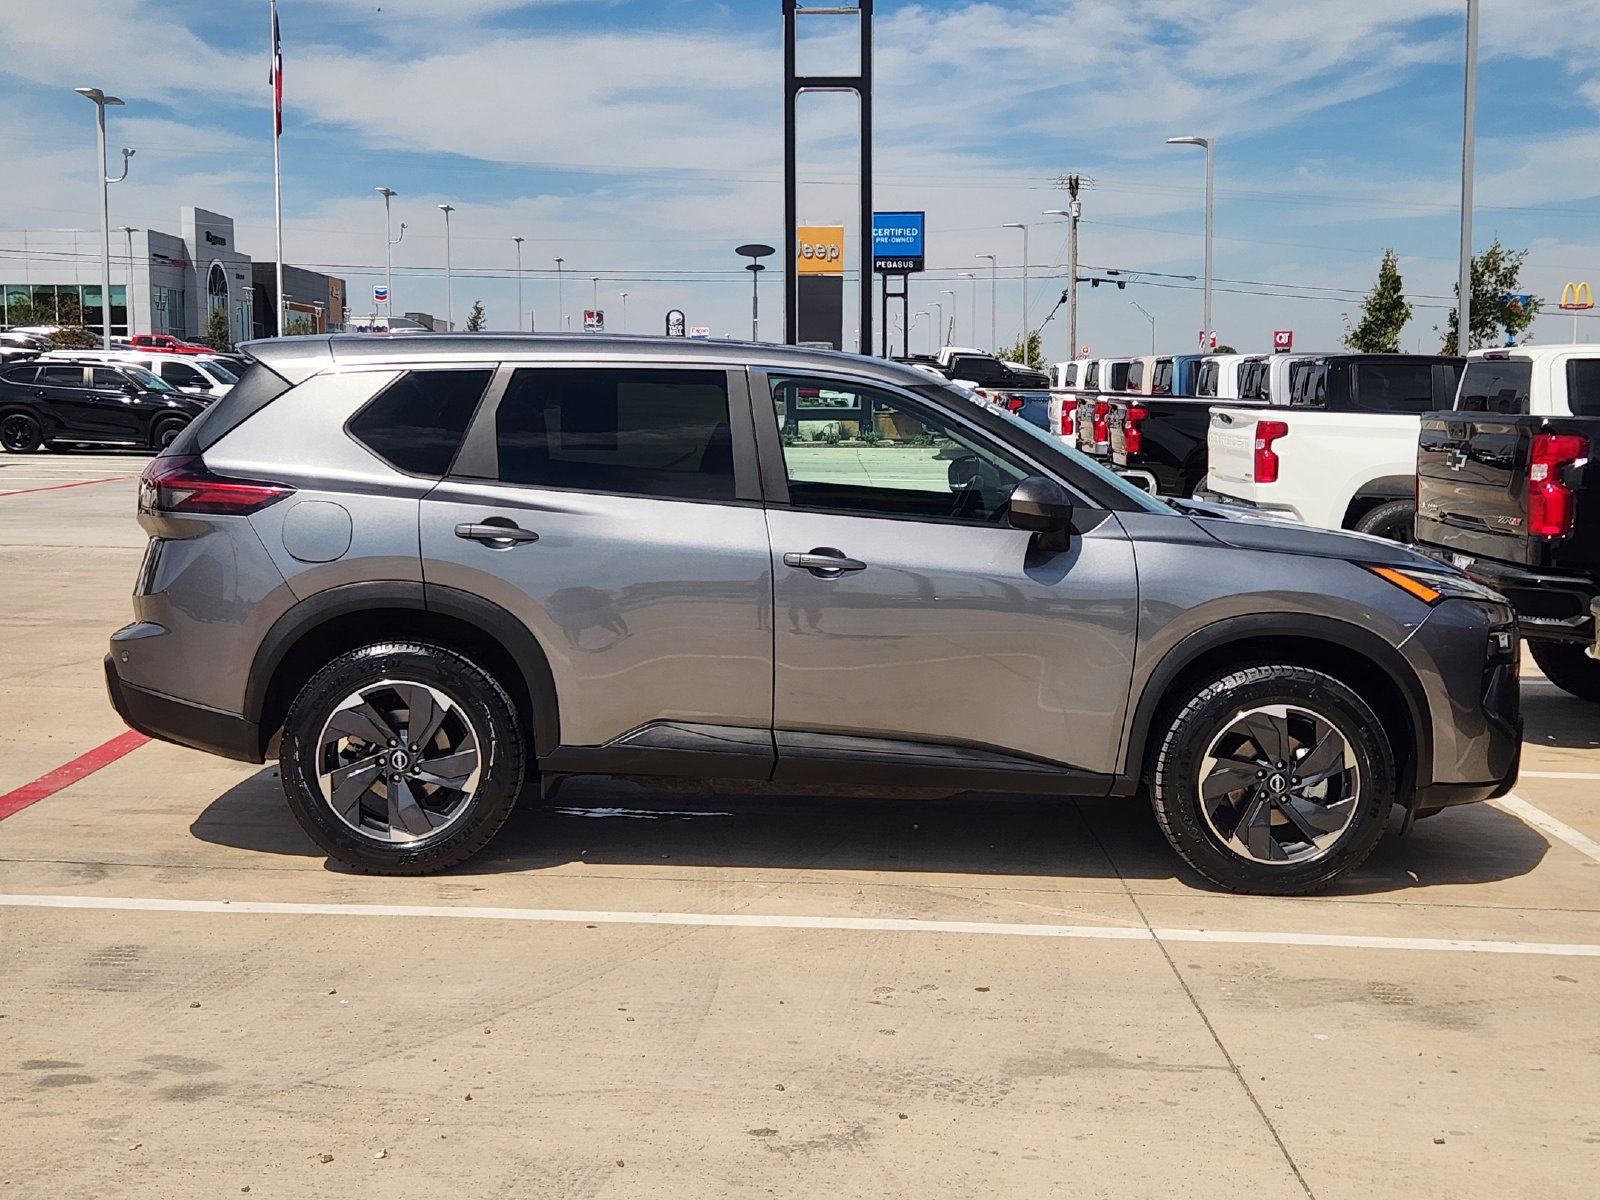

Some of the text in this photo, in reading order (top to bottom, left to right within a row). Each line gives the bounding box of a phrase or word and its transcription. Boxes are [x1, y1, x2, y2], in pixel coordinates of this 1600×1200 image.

[873, 228, 918, 237] CERTIFIED
[876, 261, 914, 269] PEGASUS
[1276, 333, 1290, 344] QT
